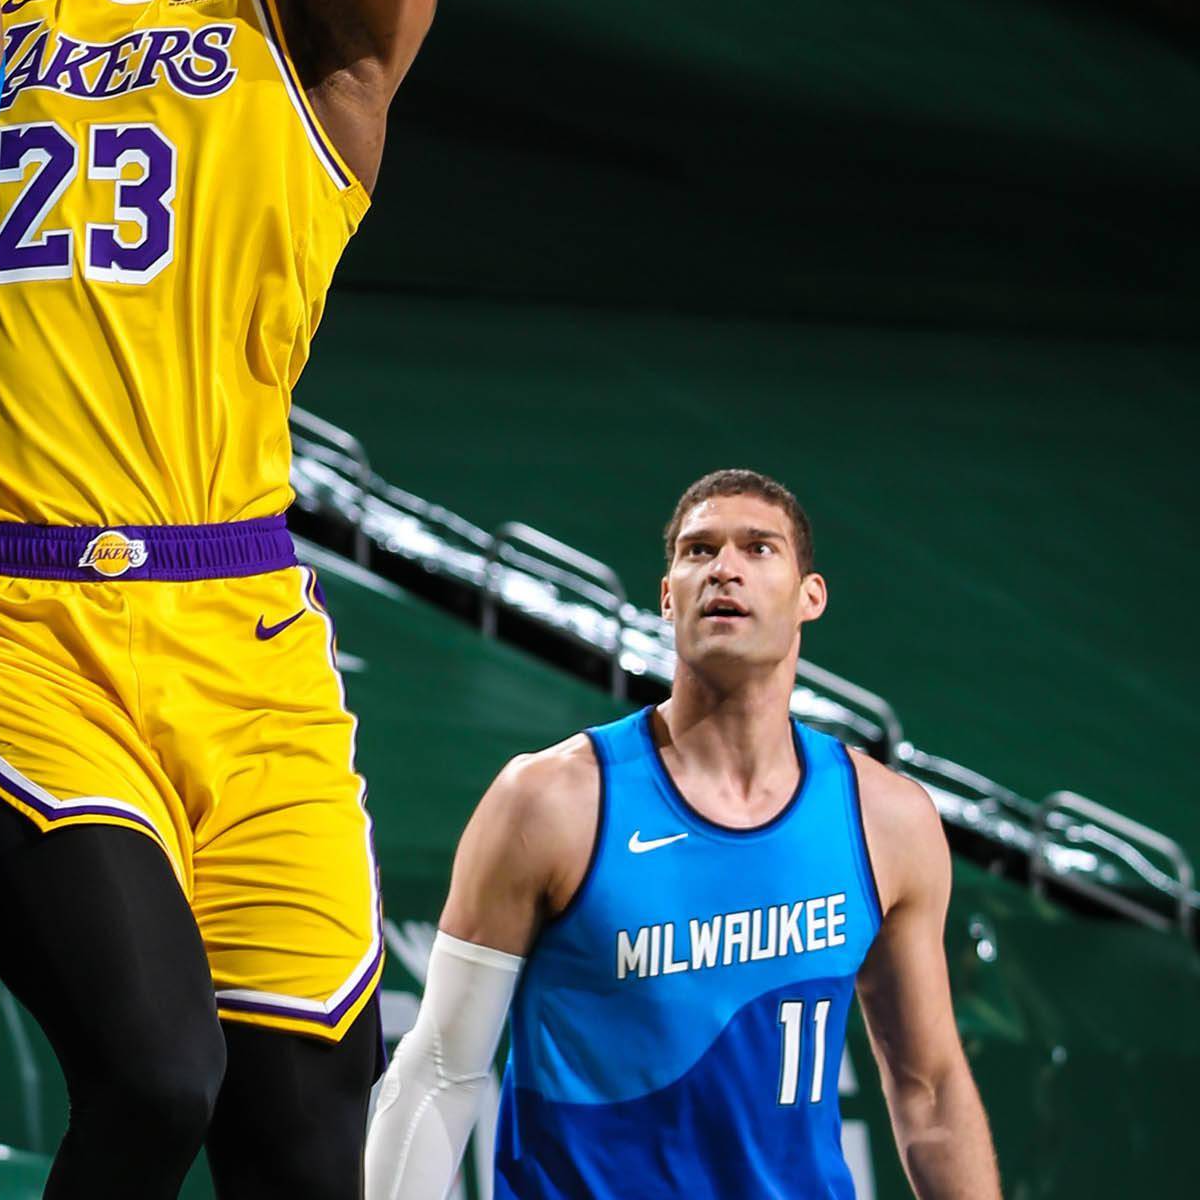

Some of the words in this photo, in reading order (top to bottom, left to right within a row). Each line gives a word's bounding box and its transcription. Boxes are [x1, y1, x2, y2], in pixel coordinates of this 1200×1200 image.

[79, 539, 149, 568] LAKERS
[615, 892, 847, 980] MILWAUKEE
[778, 999, 832, 1106] 11
